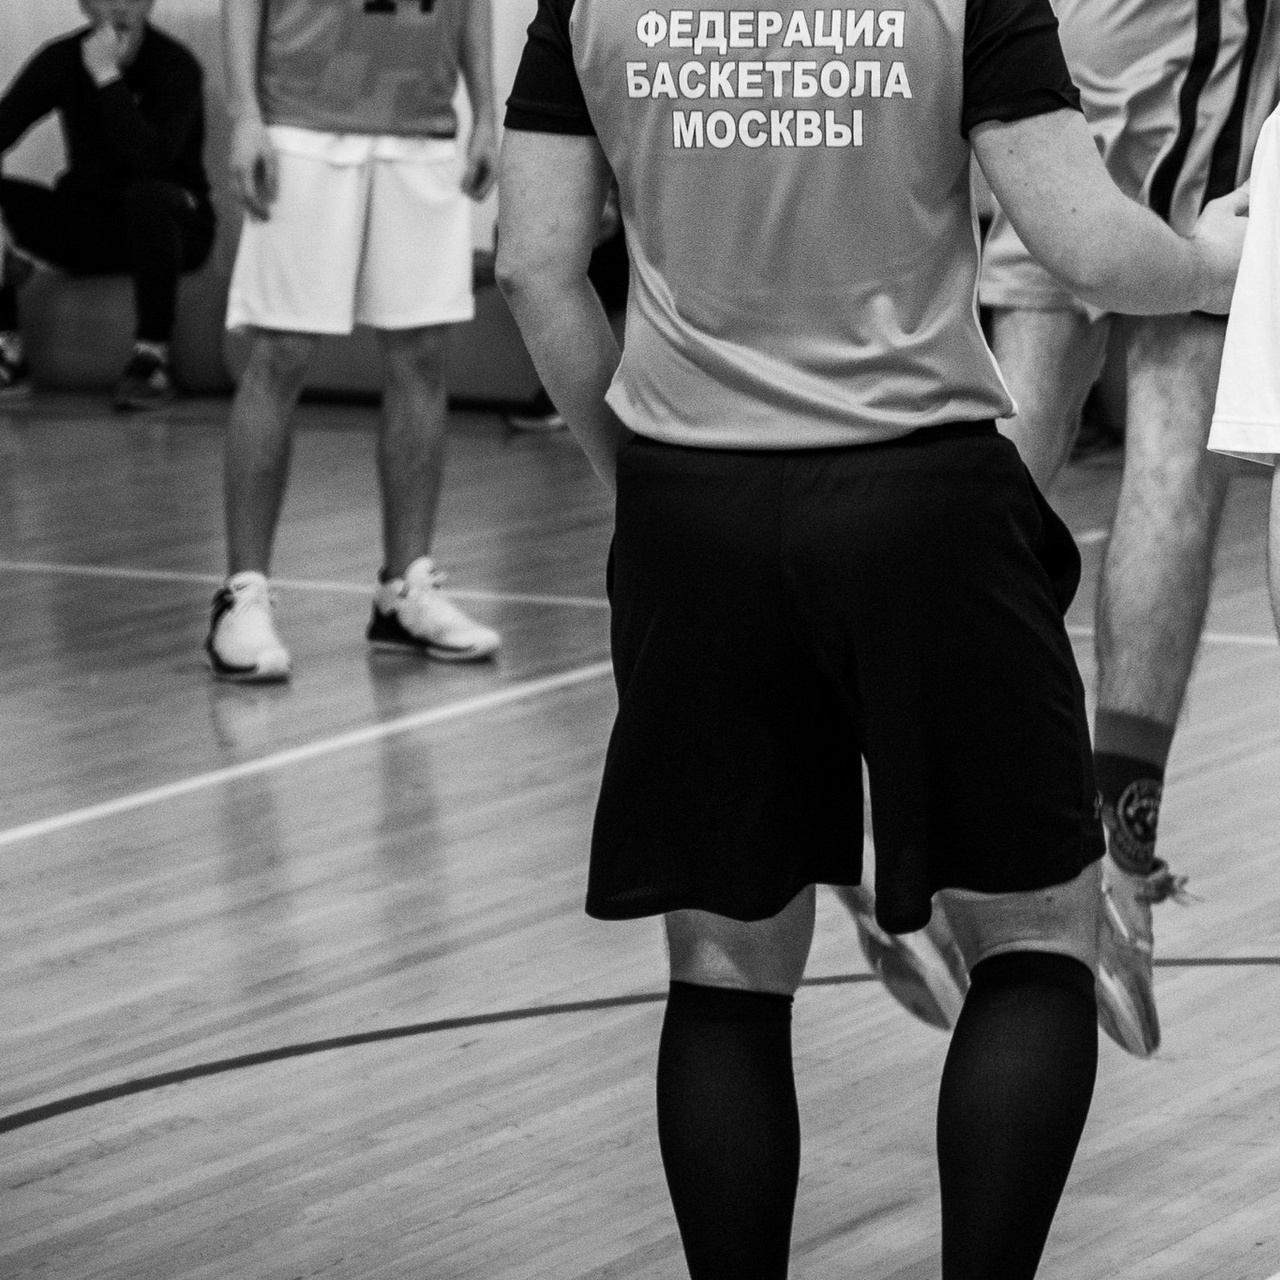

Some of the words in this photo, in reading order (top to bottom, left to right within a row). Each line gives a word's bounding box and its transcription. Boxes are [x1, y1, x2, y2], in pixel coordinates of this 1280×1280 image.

[636, 9, 906, 55] ФЕДЕРАЦИЯ
[625, 60, 913, 99] БАСКЕТБОЛА
[672, 109, 864, 148] МОСКВЫ
